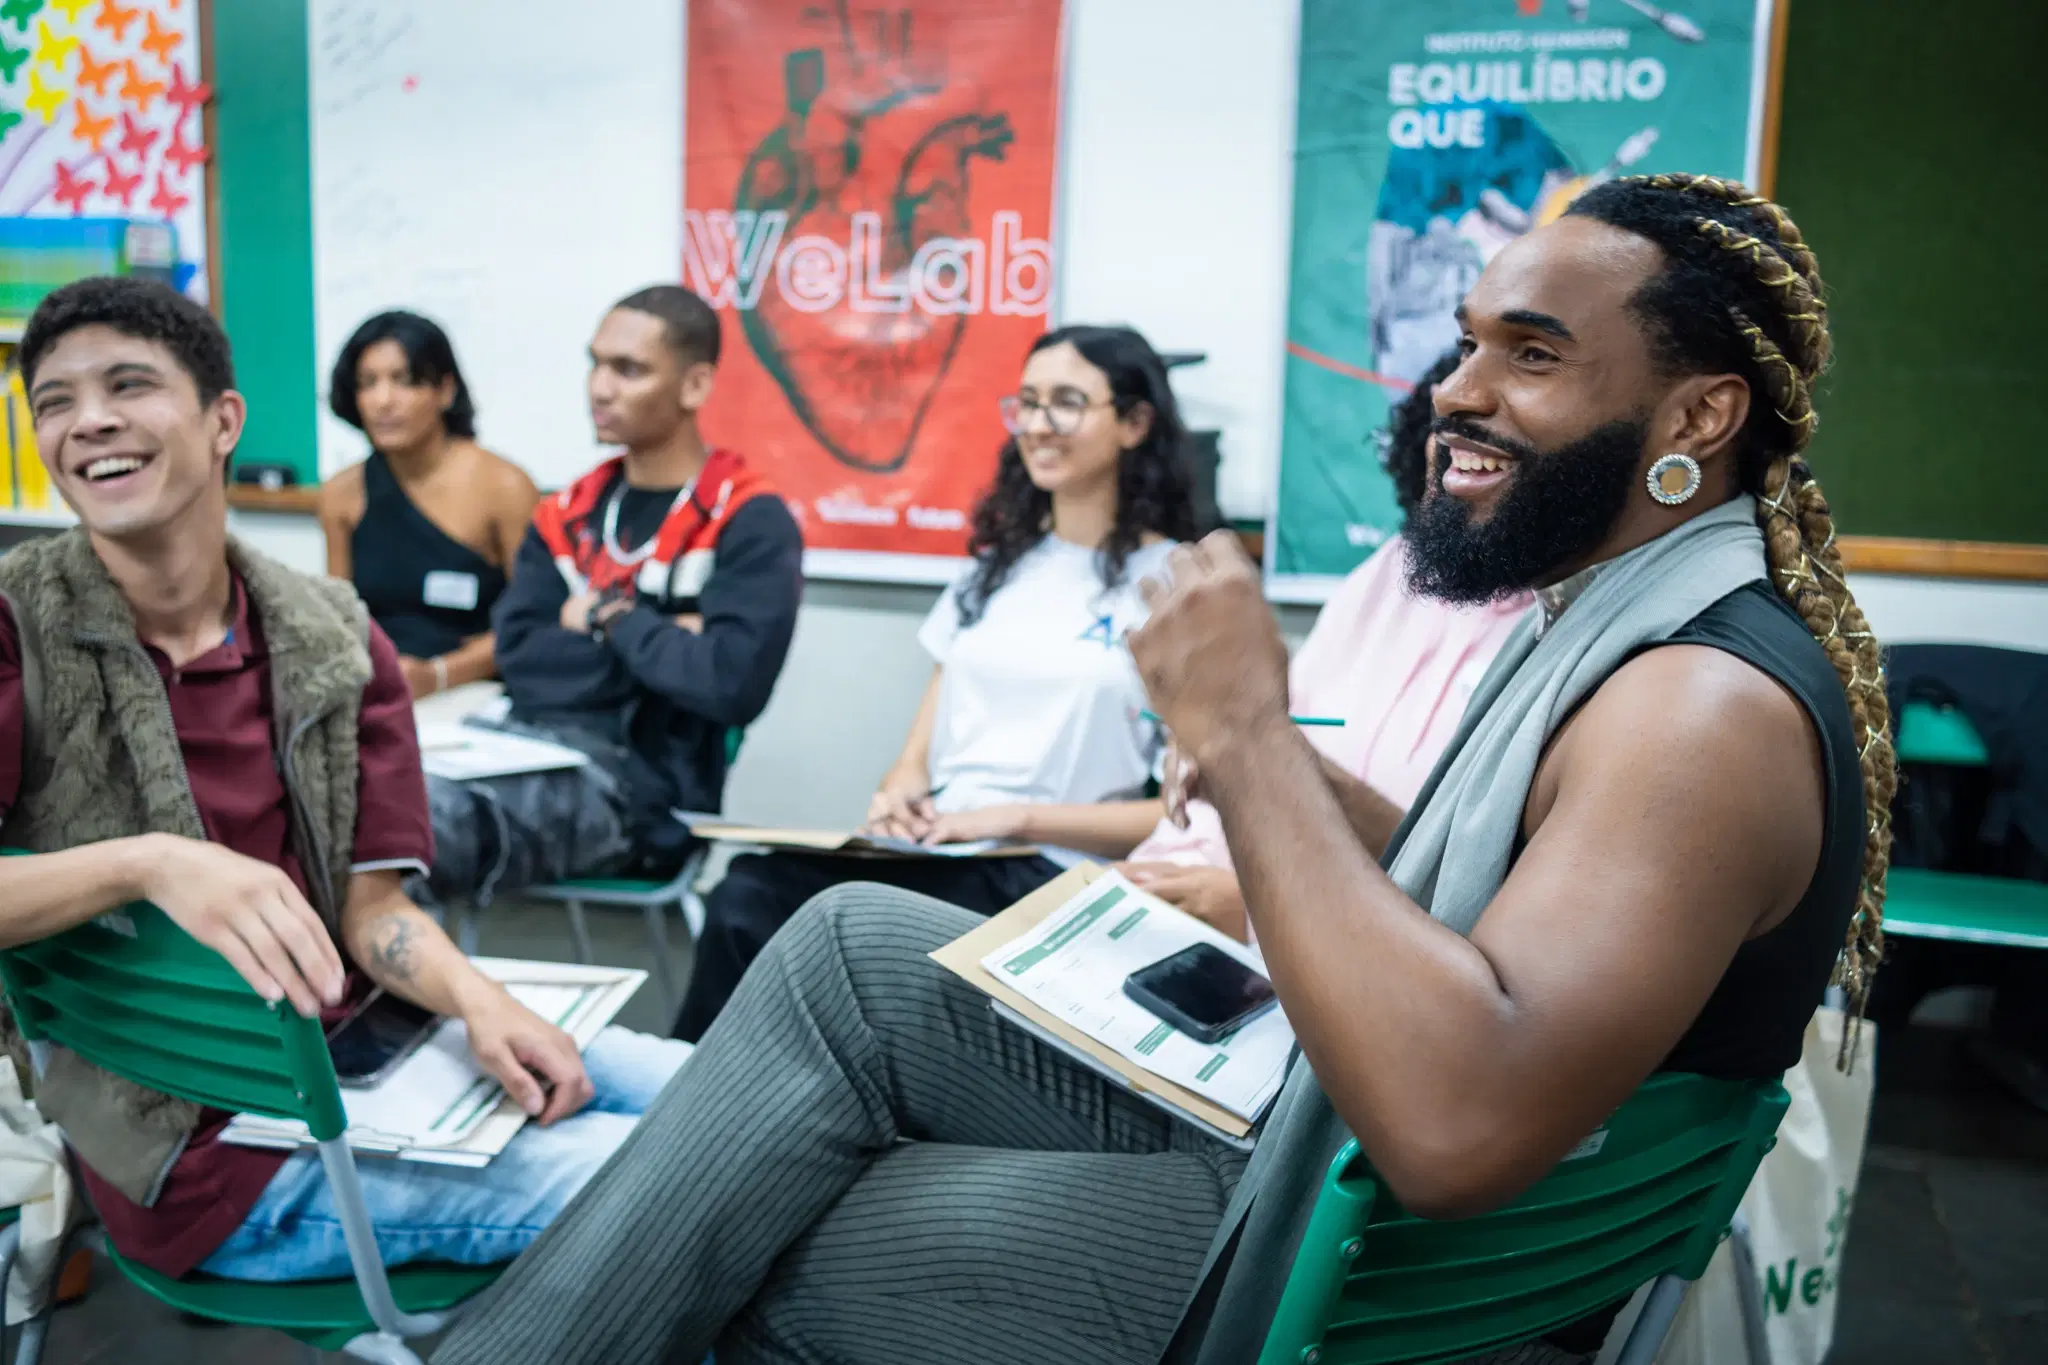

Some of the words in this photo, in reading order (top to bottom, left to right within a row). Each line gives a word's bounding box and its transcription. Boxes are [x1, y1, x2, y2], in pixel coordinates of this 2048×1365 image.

[1388, 54, 1667, 105] EQUILÍBRIO
[1388, 108, 1486, 149] QUE
[684, 209, 1054, 316] WeLab
